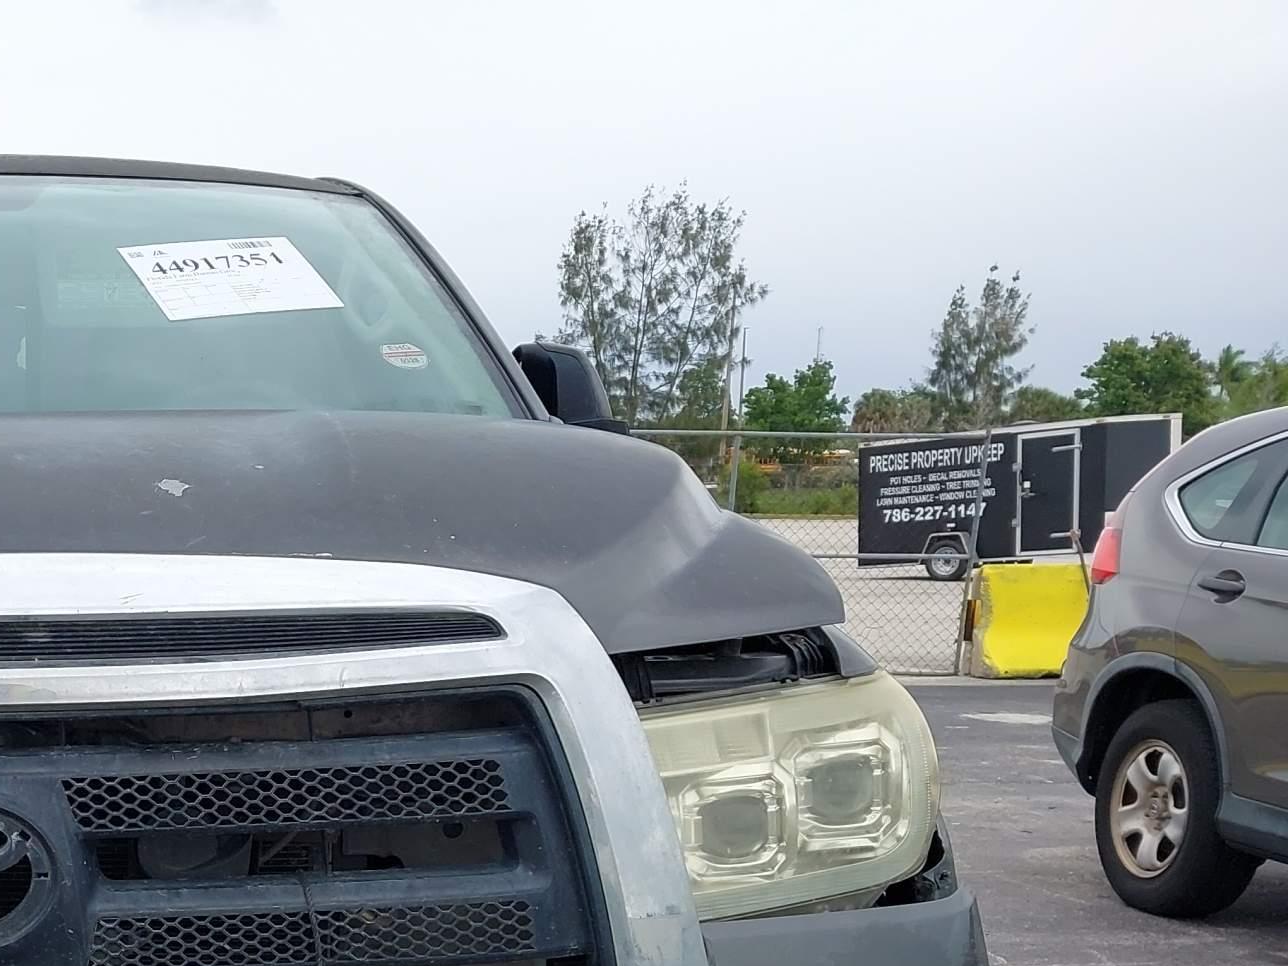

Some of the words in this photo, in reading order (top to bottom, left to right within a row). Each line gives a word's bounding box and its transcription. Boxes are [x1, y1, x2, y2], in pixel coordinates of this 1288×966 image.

[869, 453, 909, 473] PRECISE
[911, 447, 962, 469] PROPERTY
[889, 476, 901, 486] POT
[902, 474, 922, 484] HOLES
[928, 472, 948, 482] DECAL
[949, 468, 981, 480] REMOVALS
[880, 486, 911, 496] PRESSURE
[911, 483, 941, 494] CLEANING
[946, 481, 961, 490] TREE
[894, 494, 934, 504] MAINTENANCE
[939, 491, 965, 501] WINDOW
[883, 502, 987, 523] 786-227-1147
